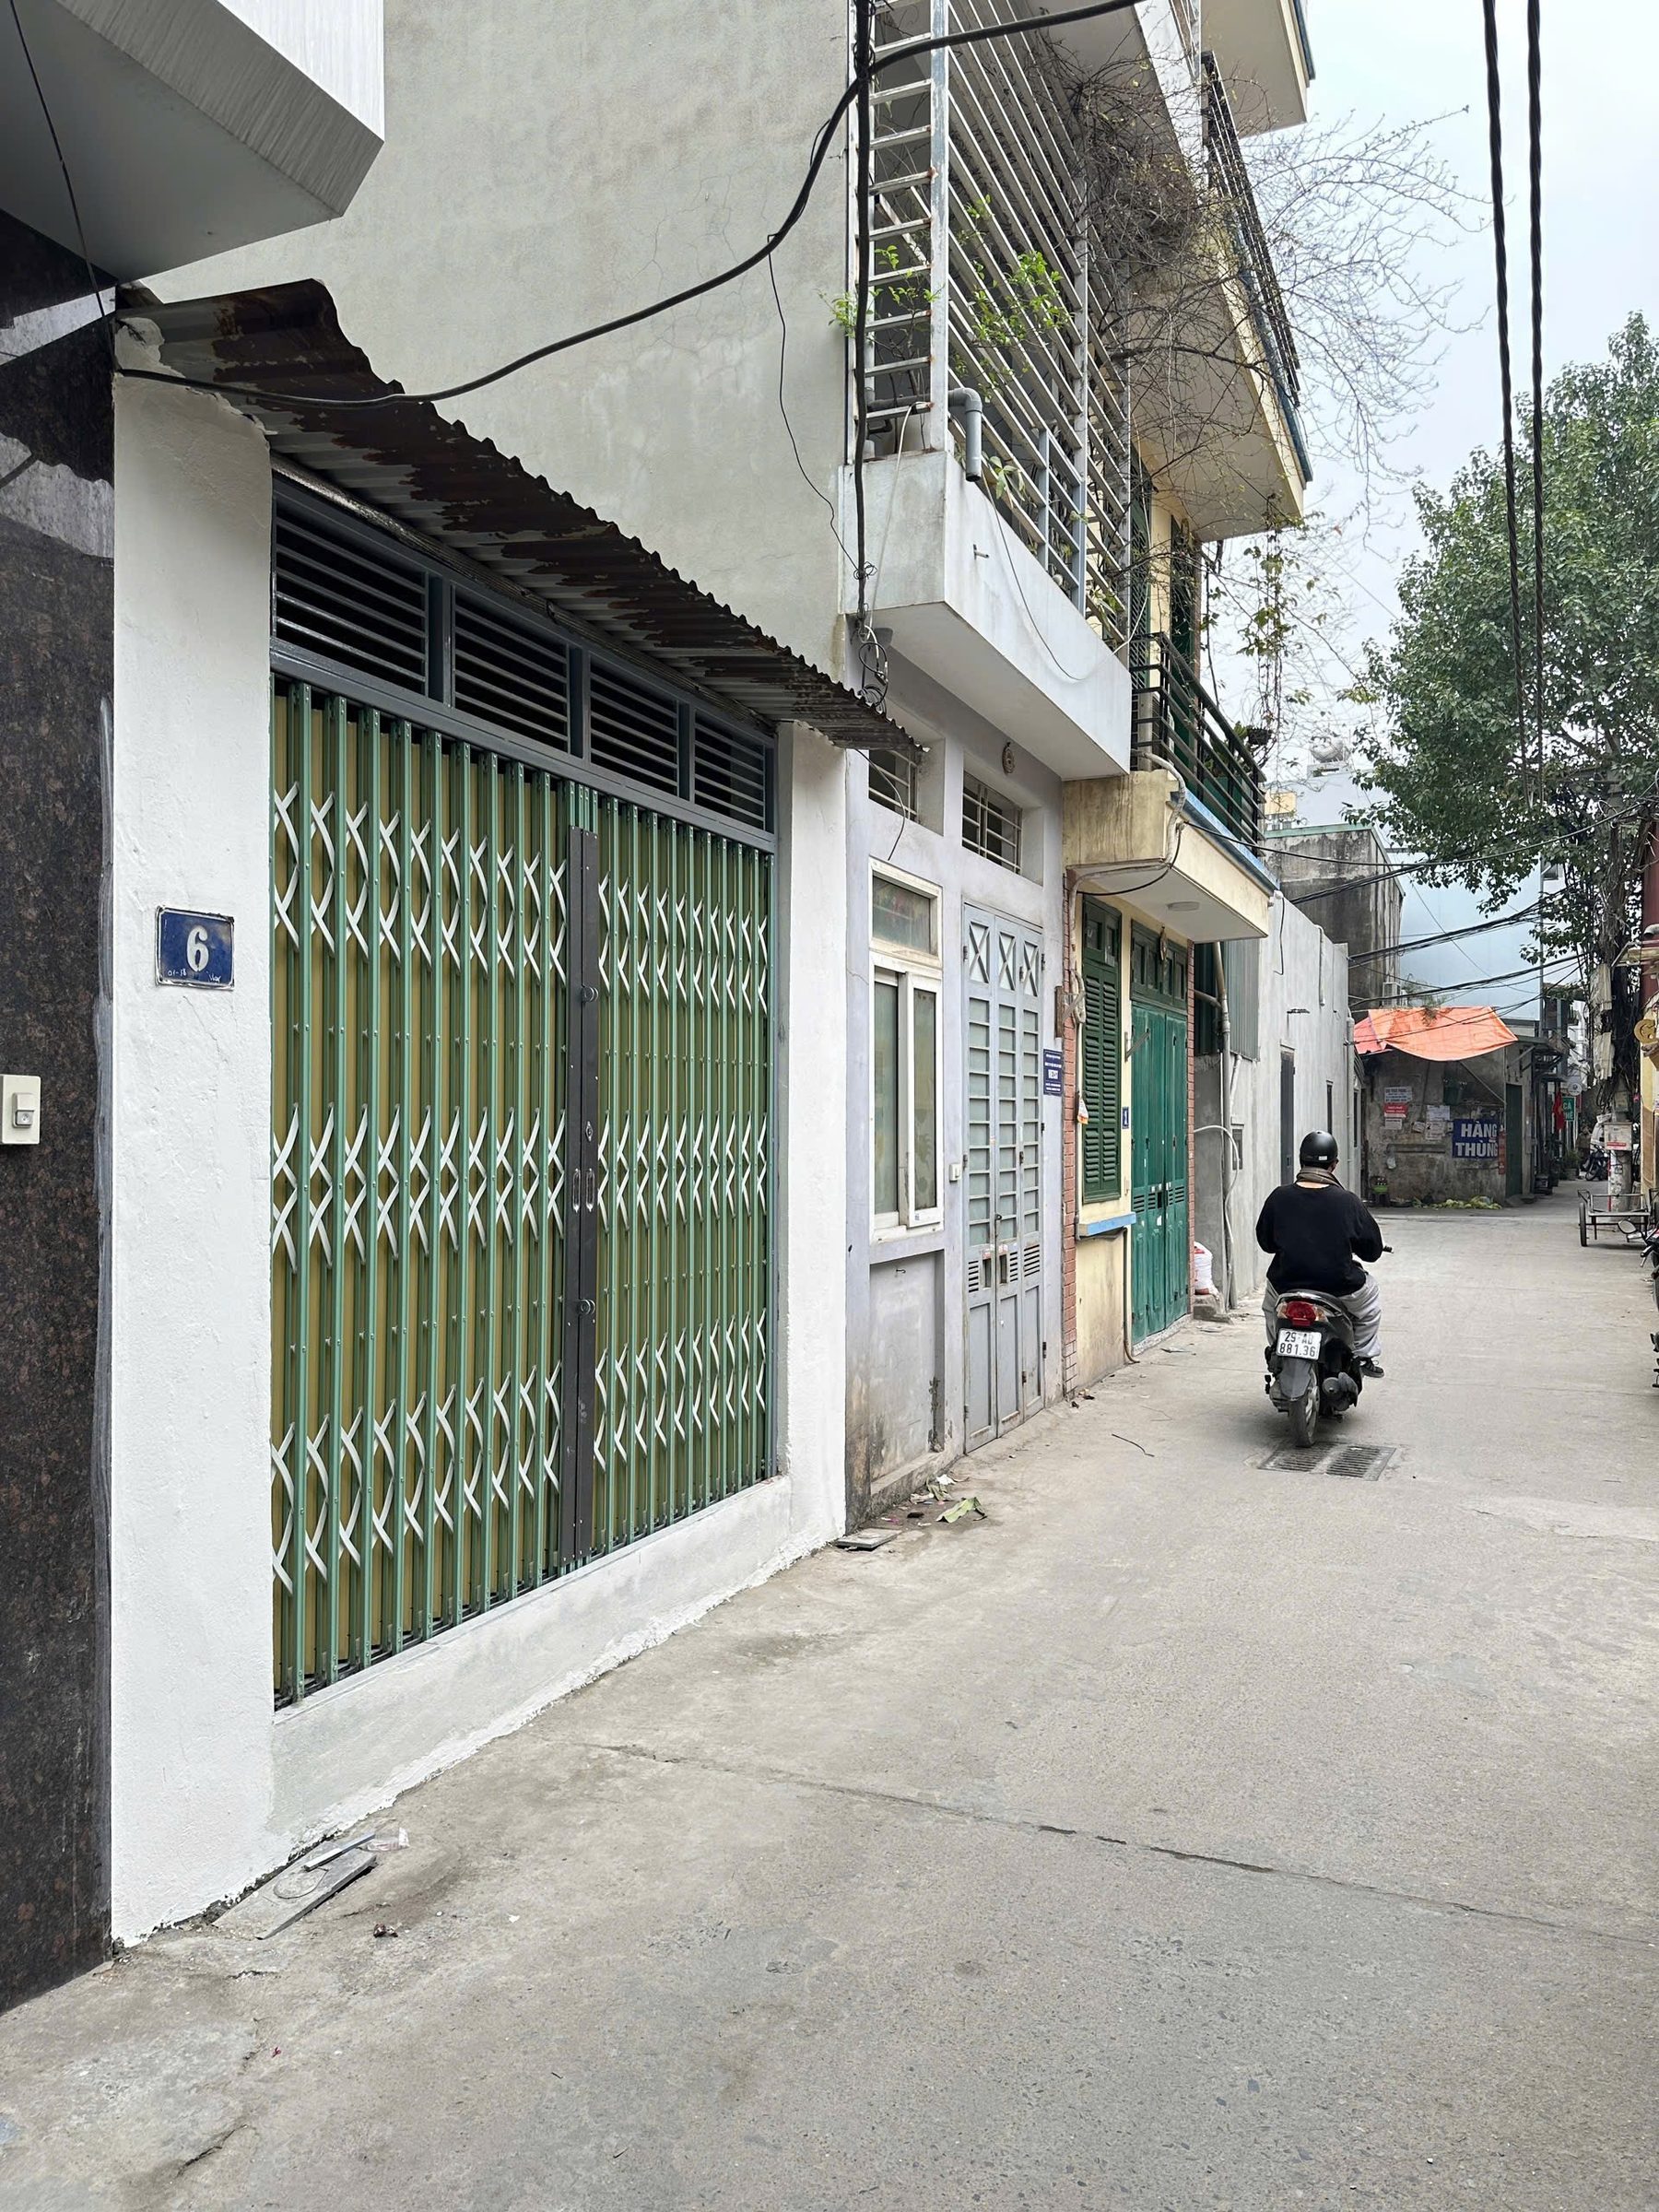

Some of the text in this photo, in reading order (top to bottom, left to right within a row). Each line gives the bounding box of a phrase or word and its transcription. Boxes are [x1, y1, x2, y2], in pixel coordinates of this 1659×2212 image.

[187, 924, 209, 972] 6
[1461, 1121, 1498, 1137] HÀNG
[1455, 1139, 1499, 1157] THÙNG
[1280, 1343, 1316, 1357] 881.36
